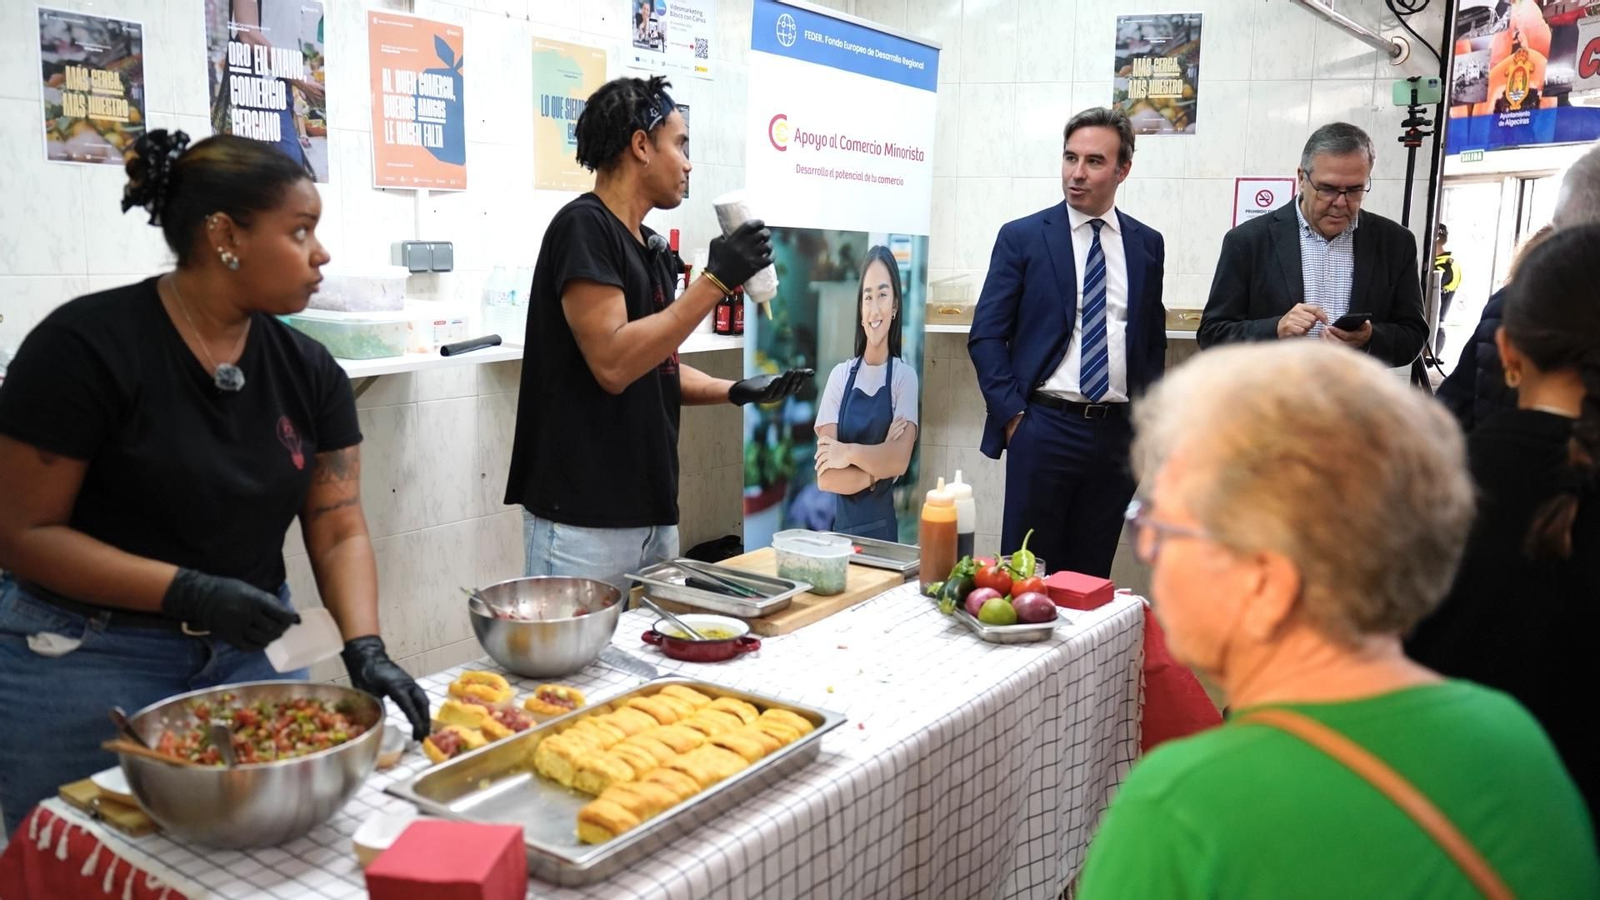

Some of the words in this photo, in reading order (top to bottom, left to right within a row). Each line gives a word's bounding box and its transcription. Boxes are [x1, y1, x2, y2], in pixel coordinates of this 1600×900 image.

[228, 41, 252, 67] ORO
[254, 45, 268, 76] EN
[271, 47, 306, 83] MANO,
[804, 30, 824, 43] FEDER.
[825, 36, 843, 48] Fondo
[843, 40, 867, 54] Europeo
[867, 47, 874, 56] de
[875, 50, 901, 63] Desarrollo
[902, 57, 925, 69] Regional
[65, 64, 89, 90] MÁS
[1133, 55, 1152, 77] MÁS
[230, 75, 287, 111] COMERCIO
[382, 68, 394, 93] AL
[395, 69, 417, 95] BUEN
[419, 72, 456, 102] COMERCIO,
[1149, 79, 1183, 94] NUESTRO
[62, 91, 86, 119] MÁS
[88, 96, 129, 117] NUESTRO
[383, 94, 416, 120] BUENOS
[418, 98, 446, 119] AMIGOS
[541, 94, 550, 117] LO
[551, 96, 564, 119] QUE
[1500, 111, 1530, 120] Ayuntamiento
[231, 109, 281, 142] CERCANO
[384, 120, 396, 144] LE
[397, 121, 421, 146] HACEN
[424, 123, 444, 148] FALTA
[1505, 118, 1530, 127] Algeciras
[794, 127, 828, 151] Apoyo
[829, 133, 838, 149] al
[840, 134, 882, 155] Comercio
[884, 142, 925, 162] Minorista
[796, 163, 829, 177] Desarrolla
[829, 168, 834, 178] el
[835, 170, 863, 181] potencial
[864, 172, 870, 182] de
[871, 173, 877, 183] tu
[877, 175, 904, 186] comercio
